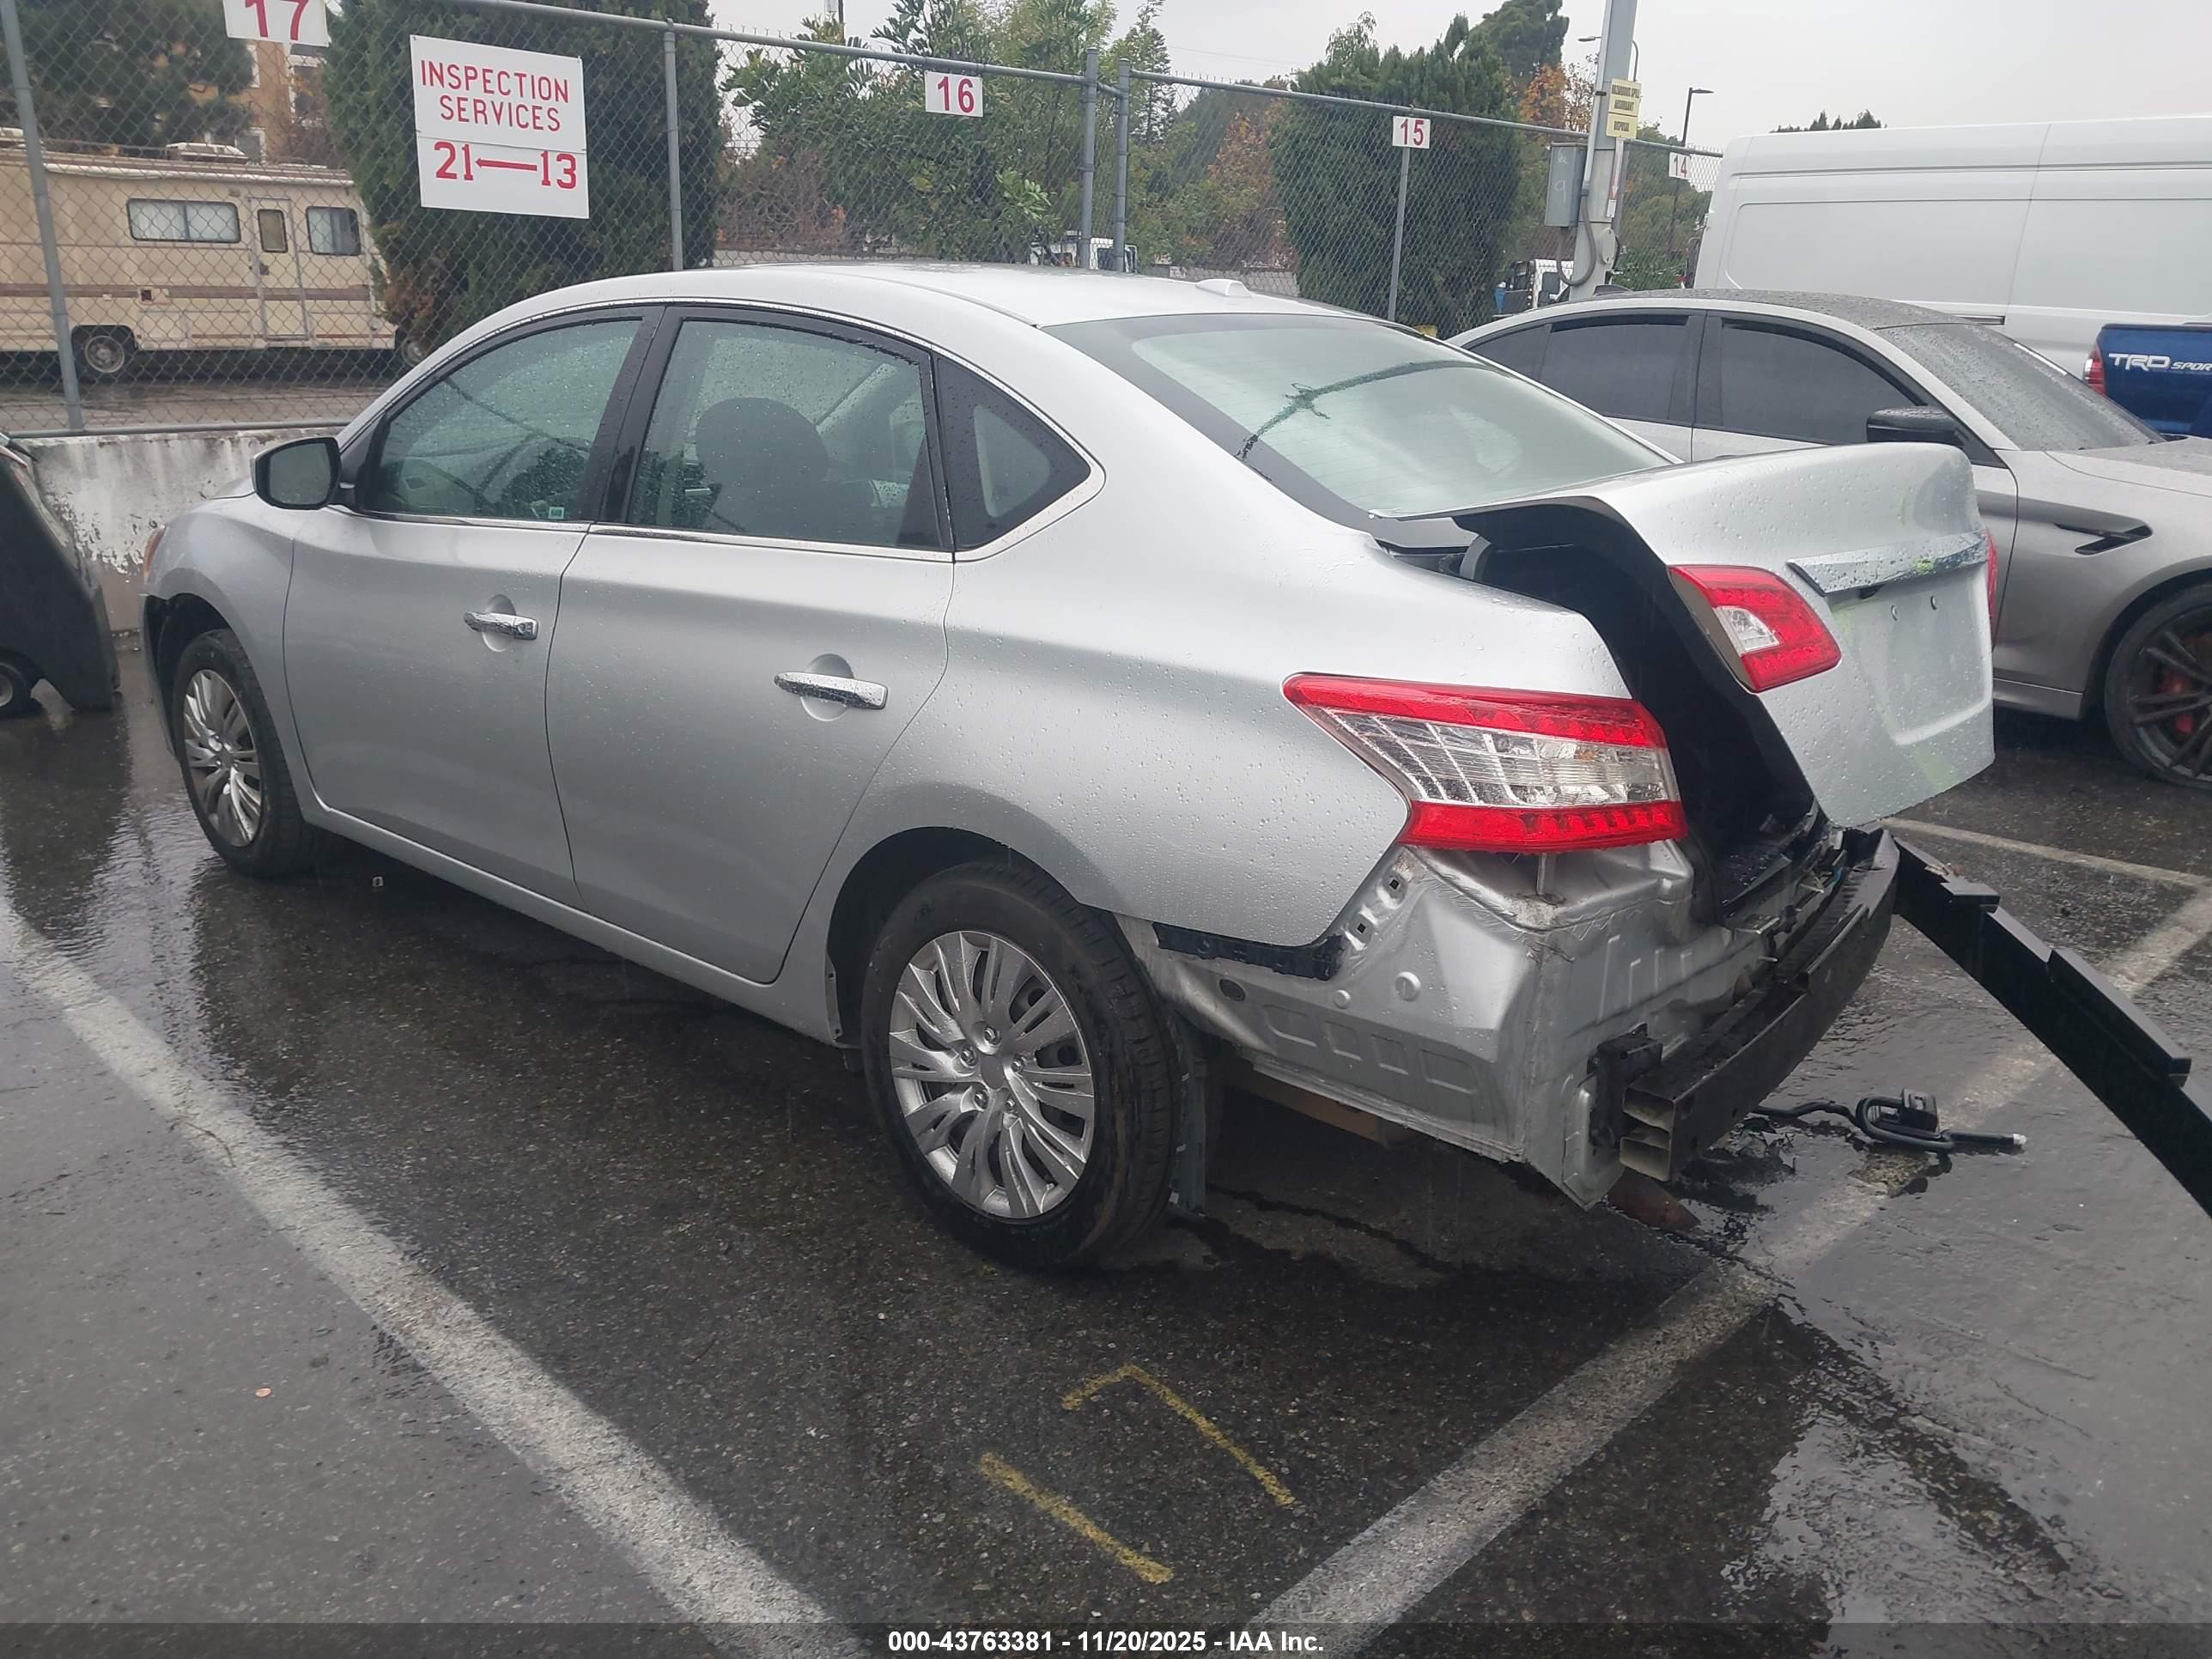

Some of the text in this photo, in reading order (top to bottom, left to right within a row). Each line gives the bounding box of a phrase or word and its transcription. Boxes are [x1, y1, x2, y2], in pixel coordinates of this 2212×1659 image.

[246, 0, 308, 41] 17
[421, 60, 568, 103] INSPECTION
[938, 76, 975, 113] 16
[440, 94, 561, 132] SERVICES
[1401, 118, 1424, 146] 15
[434, 141, 577, 190] 21 13
[1674, 154, 1687, 178] 14
[2108, 353, 2171, 371] TRD
